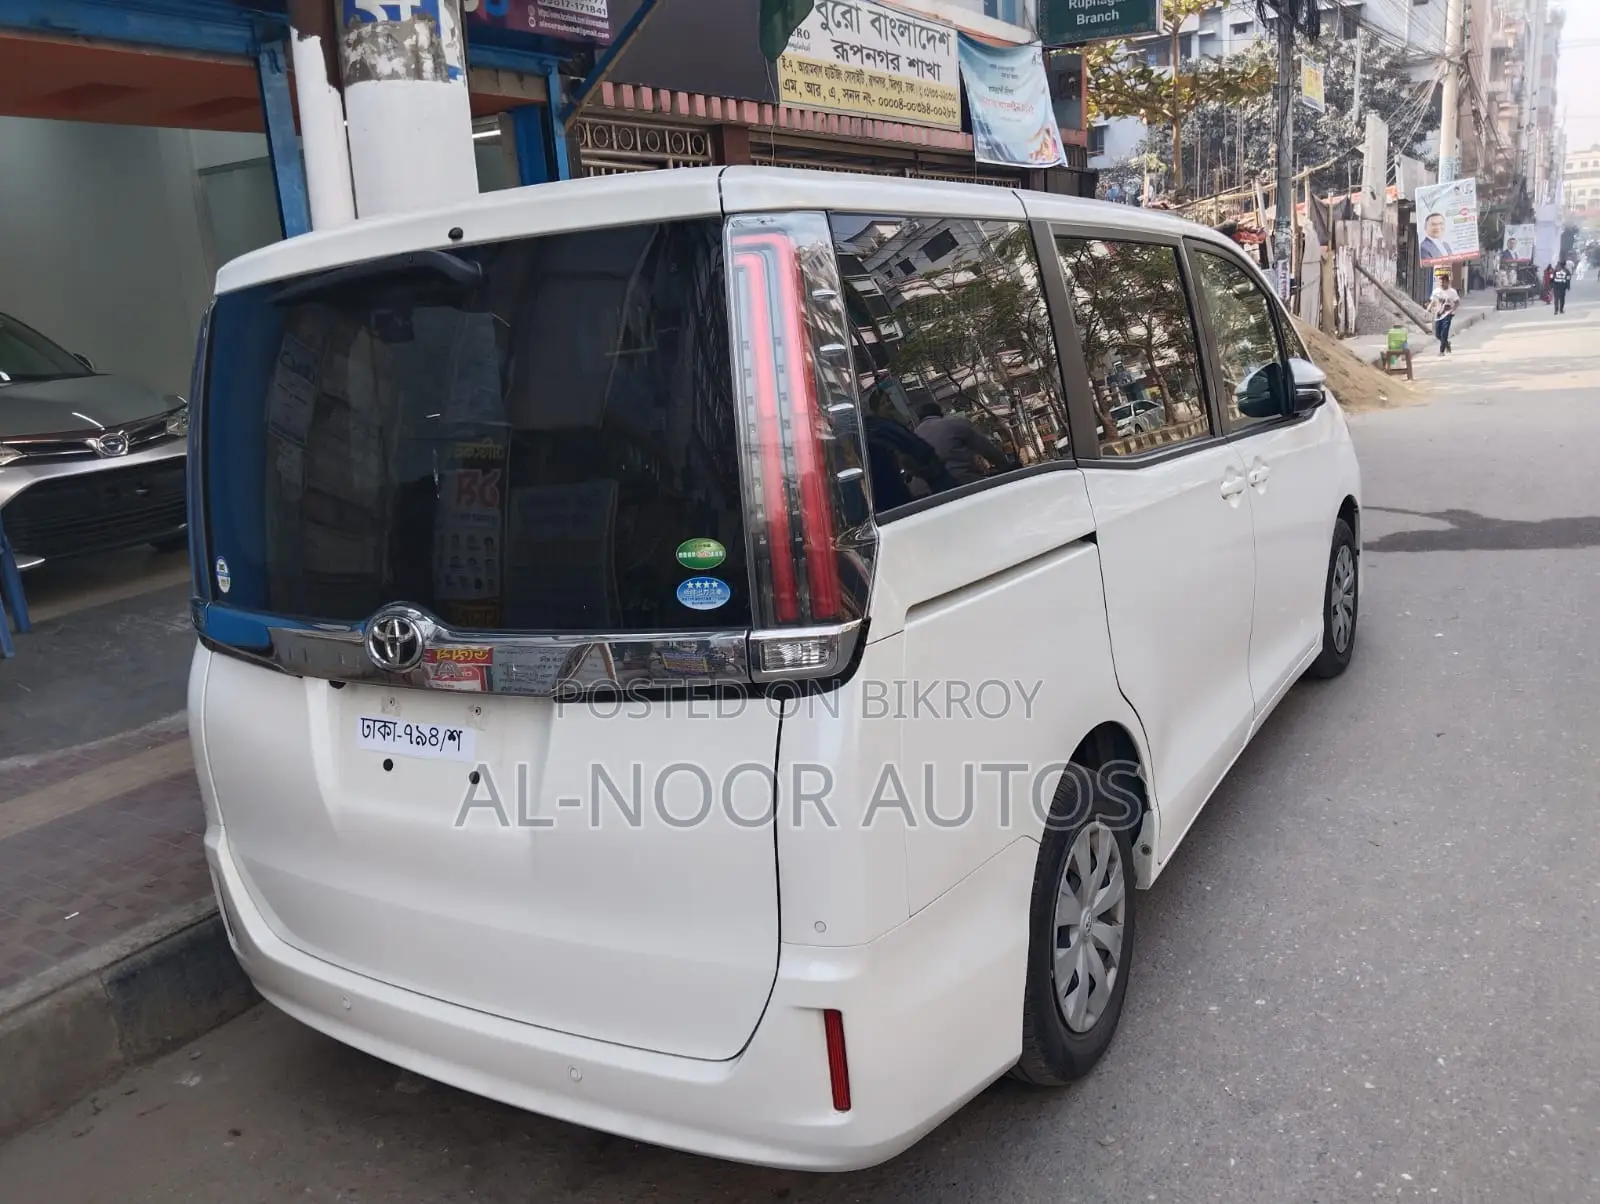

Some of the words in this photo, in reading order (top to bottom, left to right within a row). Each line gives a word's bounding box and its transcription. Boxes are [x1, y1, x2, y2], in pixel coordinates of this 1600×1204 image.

[1069, 0, 1125, 9] Rupnag
[1076, 9, 1120, 25] Branch
[815, 0, 862, 36] বুরো
[867, 10, 951, 56] বাংলাদেশ
[830, 39, 901, 72] রূপনগর
[906, 56, 941, 81] শাখা
